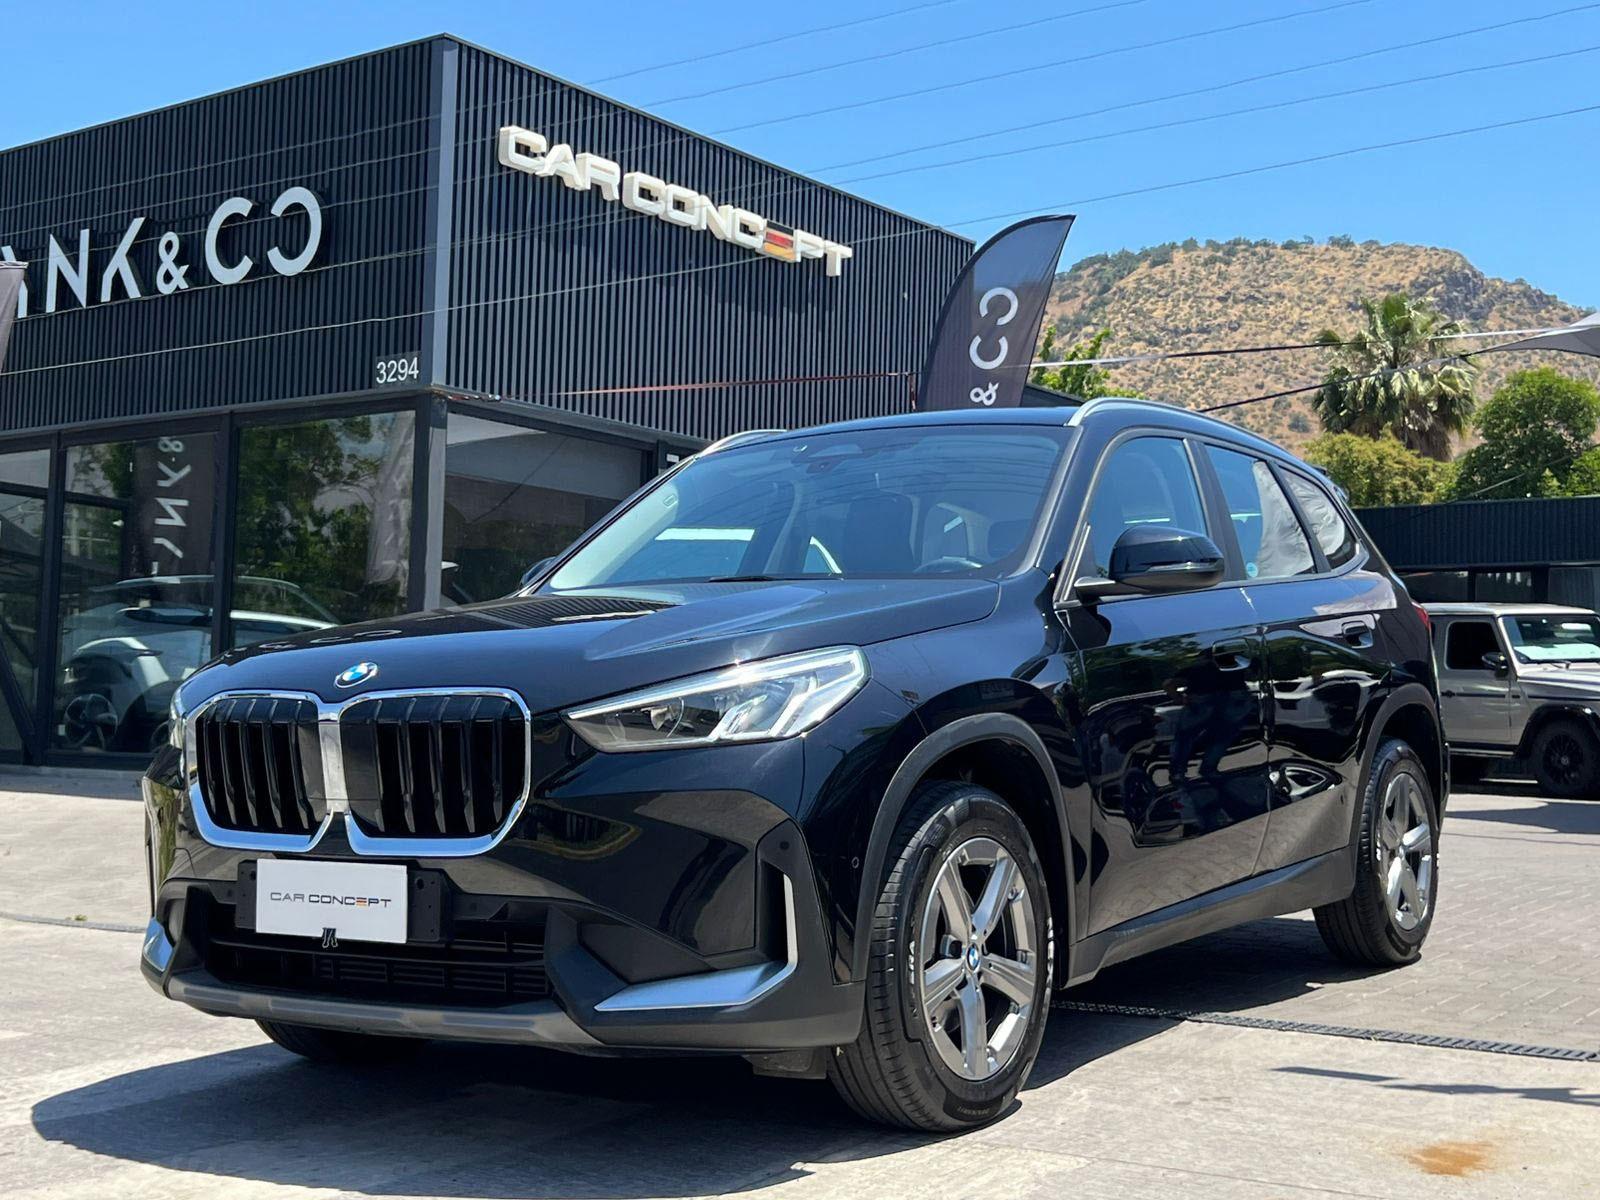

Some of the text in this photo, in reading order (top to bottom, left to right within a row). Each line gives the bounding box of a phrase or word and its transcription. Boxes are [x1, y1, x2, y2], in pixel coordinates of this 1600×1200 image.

[499, 125, 853, 277] CAR CONCEPT
[376, 356, 420, 384] 3294
[270, 891, 392, 908] CAR CONCEPT
